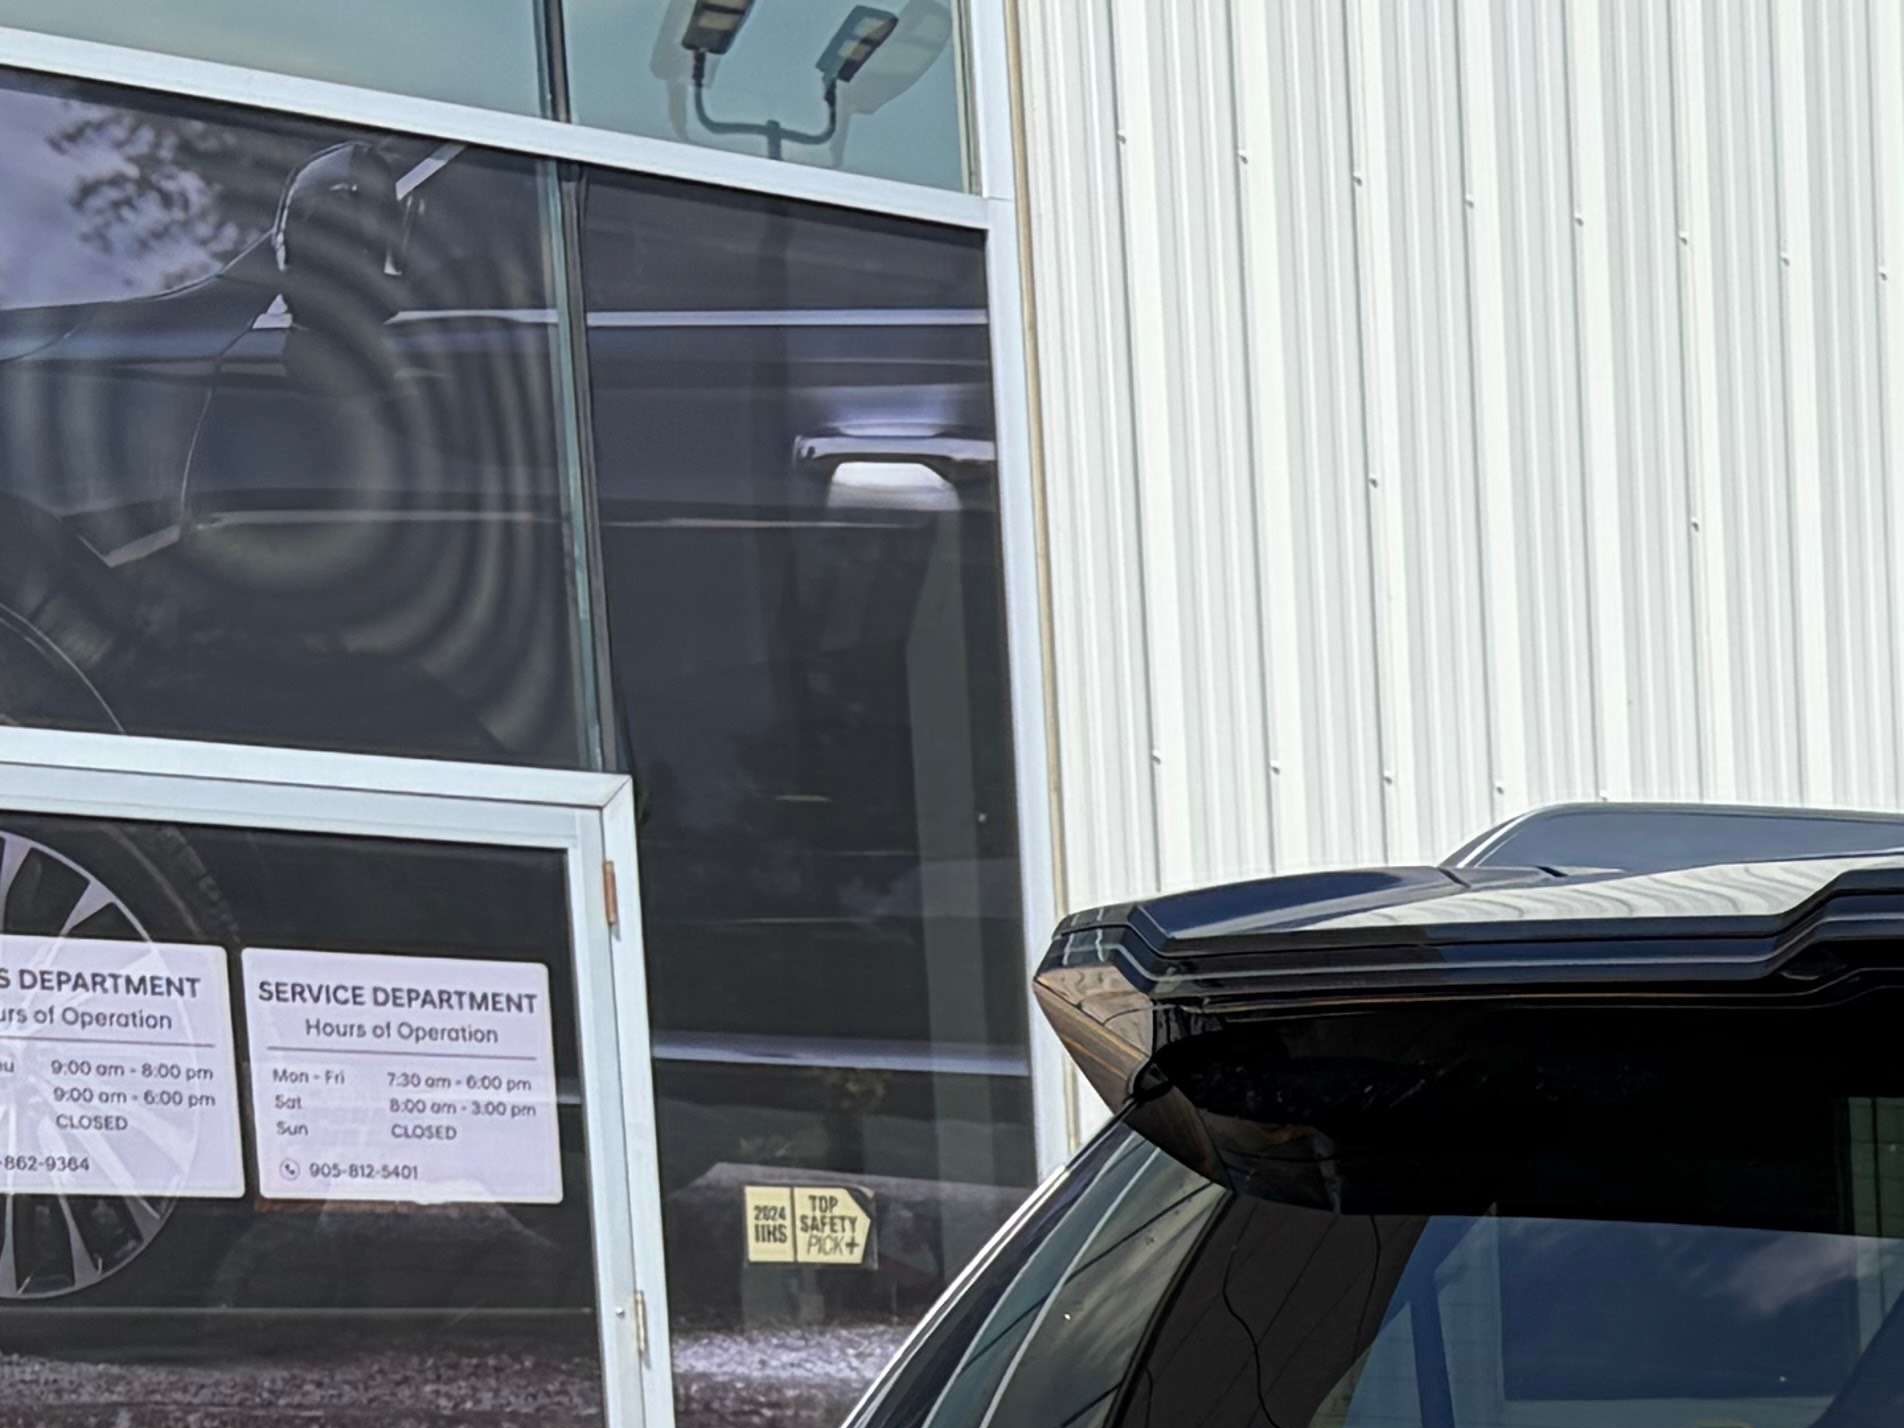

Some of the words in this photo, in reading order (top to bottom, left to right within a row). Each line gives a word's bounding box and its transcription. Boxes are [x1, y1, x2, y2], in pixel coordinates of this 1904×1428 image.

[19, 968, 201, 998] DEPARTMENT
[258, 980, 366, 1006] SERVICE
[372, 985, 538, 1014] DEPARTMENT
[33, 1005, 55, 1024] of
[61, 1006, 173, 1031] Operation
[305, 1018, 367, 1039] Hours
[372, 1020, 391, 1039] of
[397, 1021, 499, 1044] Operation
[50, 1059, 92, 1076] 9:00
[95, 1063, 125, 1077] am
[141, 1063, 181, 1079] 8:00
[185, 1066, 214, 1081] pm
[272, 1068, 310, 1085] Mon
[324, 1069, 345, 1085] Fri
[387, 1072, 422, 1088] 7:30
[424, 1075, 452, 1090] am
[506, 1078, 532, 1094] pm
[53, 1087, 94, 1103] 9:00
[97, 1091, 128, 1104] am
[143, 1090, 184, 1106] 6:00
[187, 1094, 216, 1109] pm
[274, 1095, 302, 1111] Sat
[430, 1102, 458, 1116] am
[510, 1104, 537, 1120] pm
[56, 1113, 129, 1132] CLOSED
[275, 1120, 309, 1137] Sun
[390, 1123, 458, 1141] CLOSED
[0, 1155, 91, 1172] -862-9364
[308, 1162, 419, 1181] 905-812-5401
[753, 1204, 787, 1222] 2024
[808, 1195, 839, 1213] TOP
[800, 1215, 858, 1233] SAFETY
